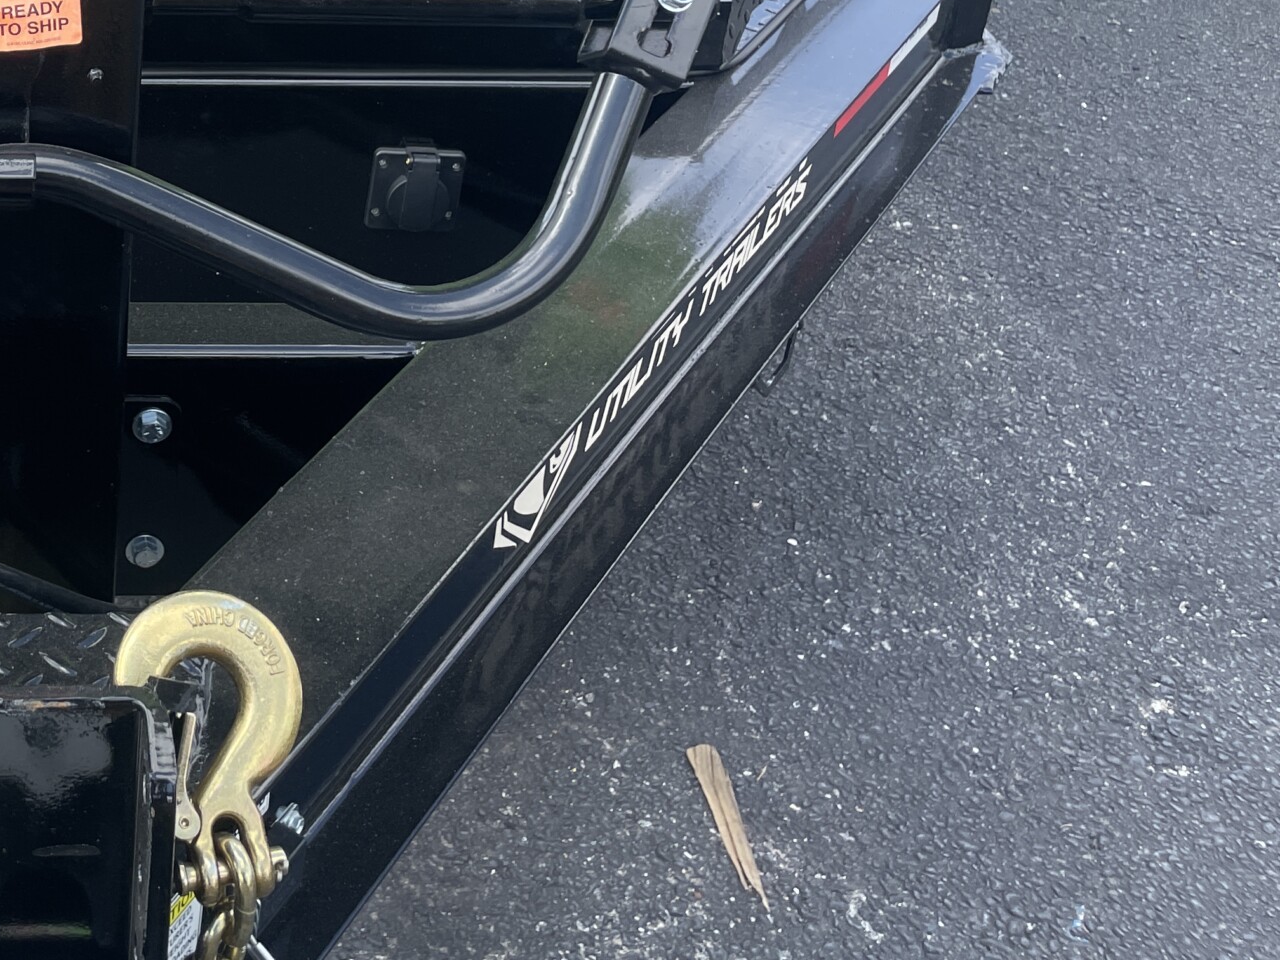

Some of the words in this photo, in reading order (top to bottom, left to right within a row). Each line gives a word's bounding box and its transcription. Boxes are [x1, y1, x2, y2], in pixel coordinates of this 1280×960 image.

[1, 1, 63, 19] READY
[27, 18, 69, 35] SHIP
[585, 298, 695, 452] UTILITY
[699, 163, 813, 317] TRAILERS
[184, 606, 235, 628] CHINA
[238, 615, 285, 676] FORGED
